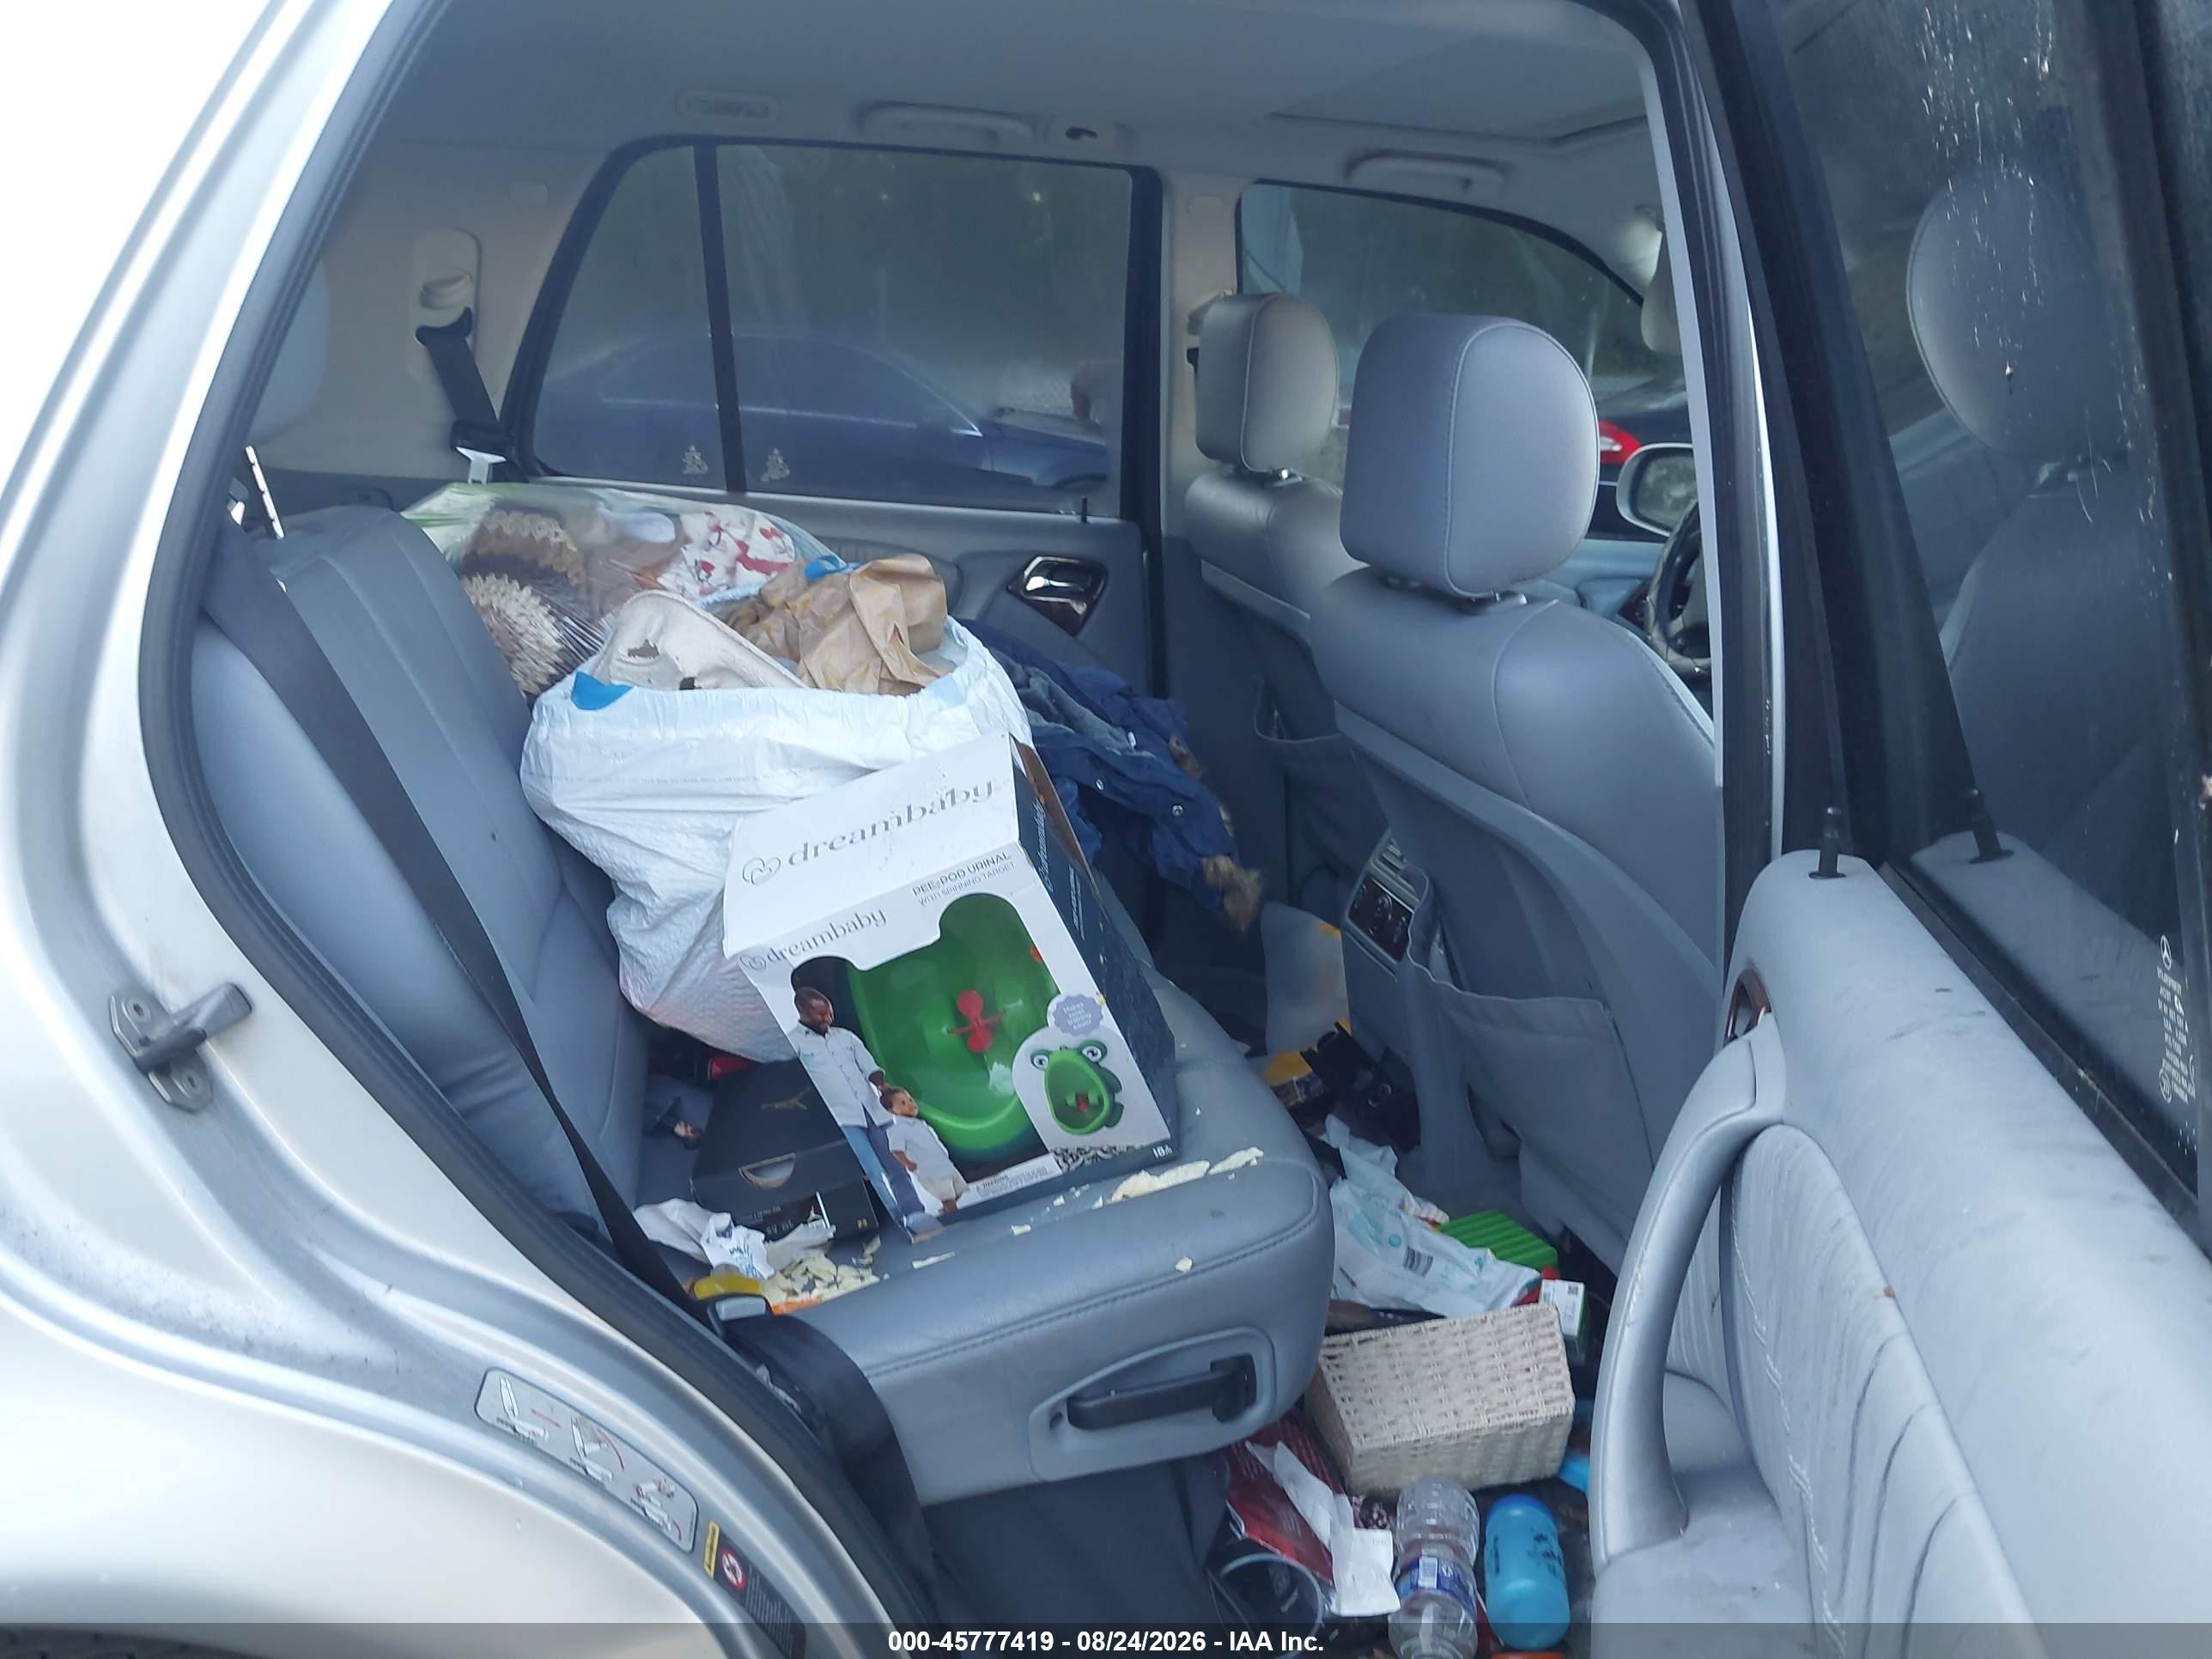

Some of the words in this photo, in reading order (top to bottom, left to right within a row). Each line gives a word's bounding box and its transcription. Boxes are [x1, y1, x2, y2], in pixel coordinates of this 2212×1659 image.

[787, 780, 994, 866] dreambaby
[967, 851, 1010, 874] URINAL
[982, 861, 1017, 881] TARGET
[766, 906, 888, 963] dreambaby
